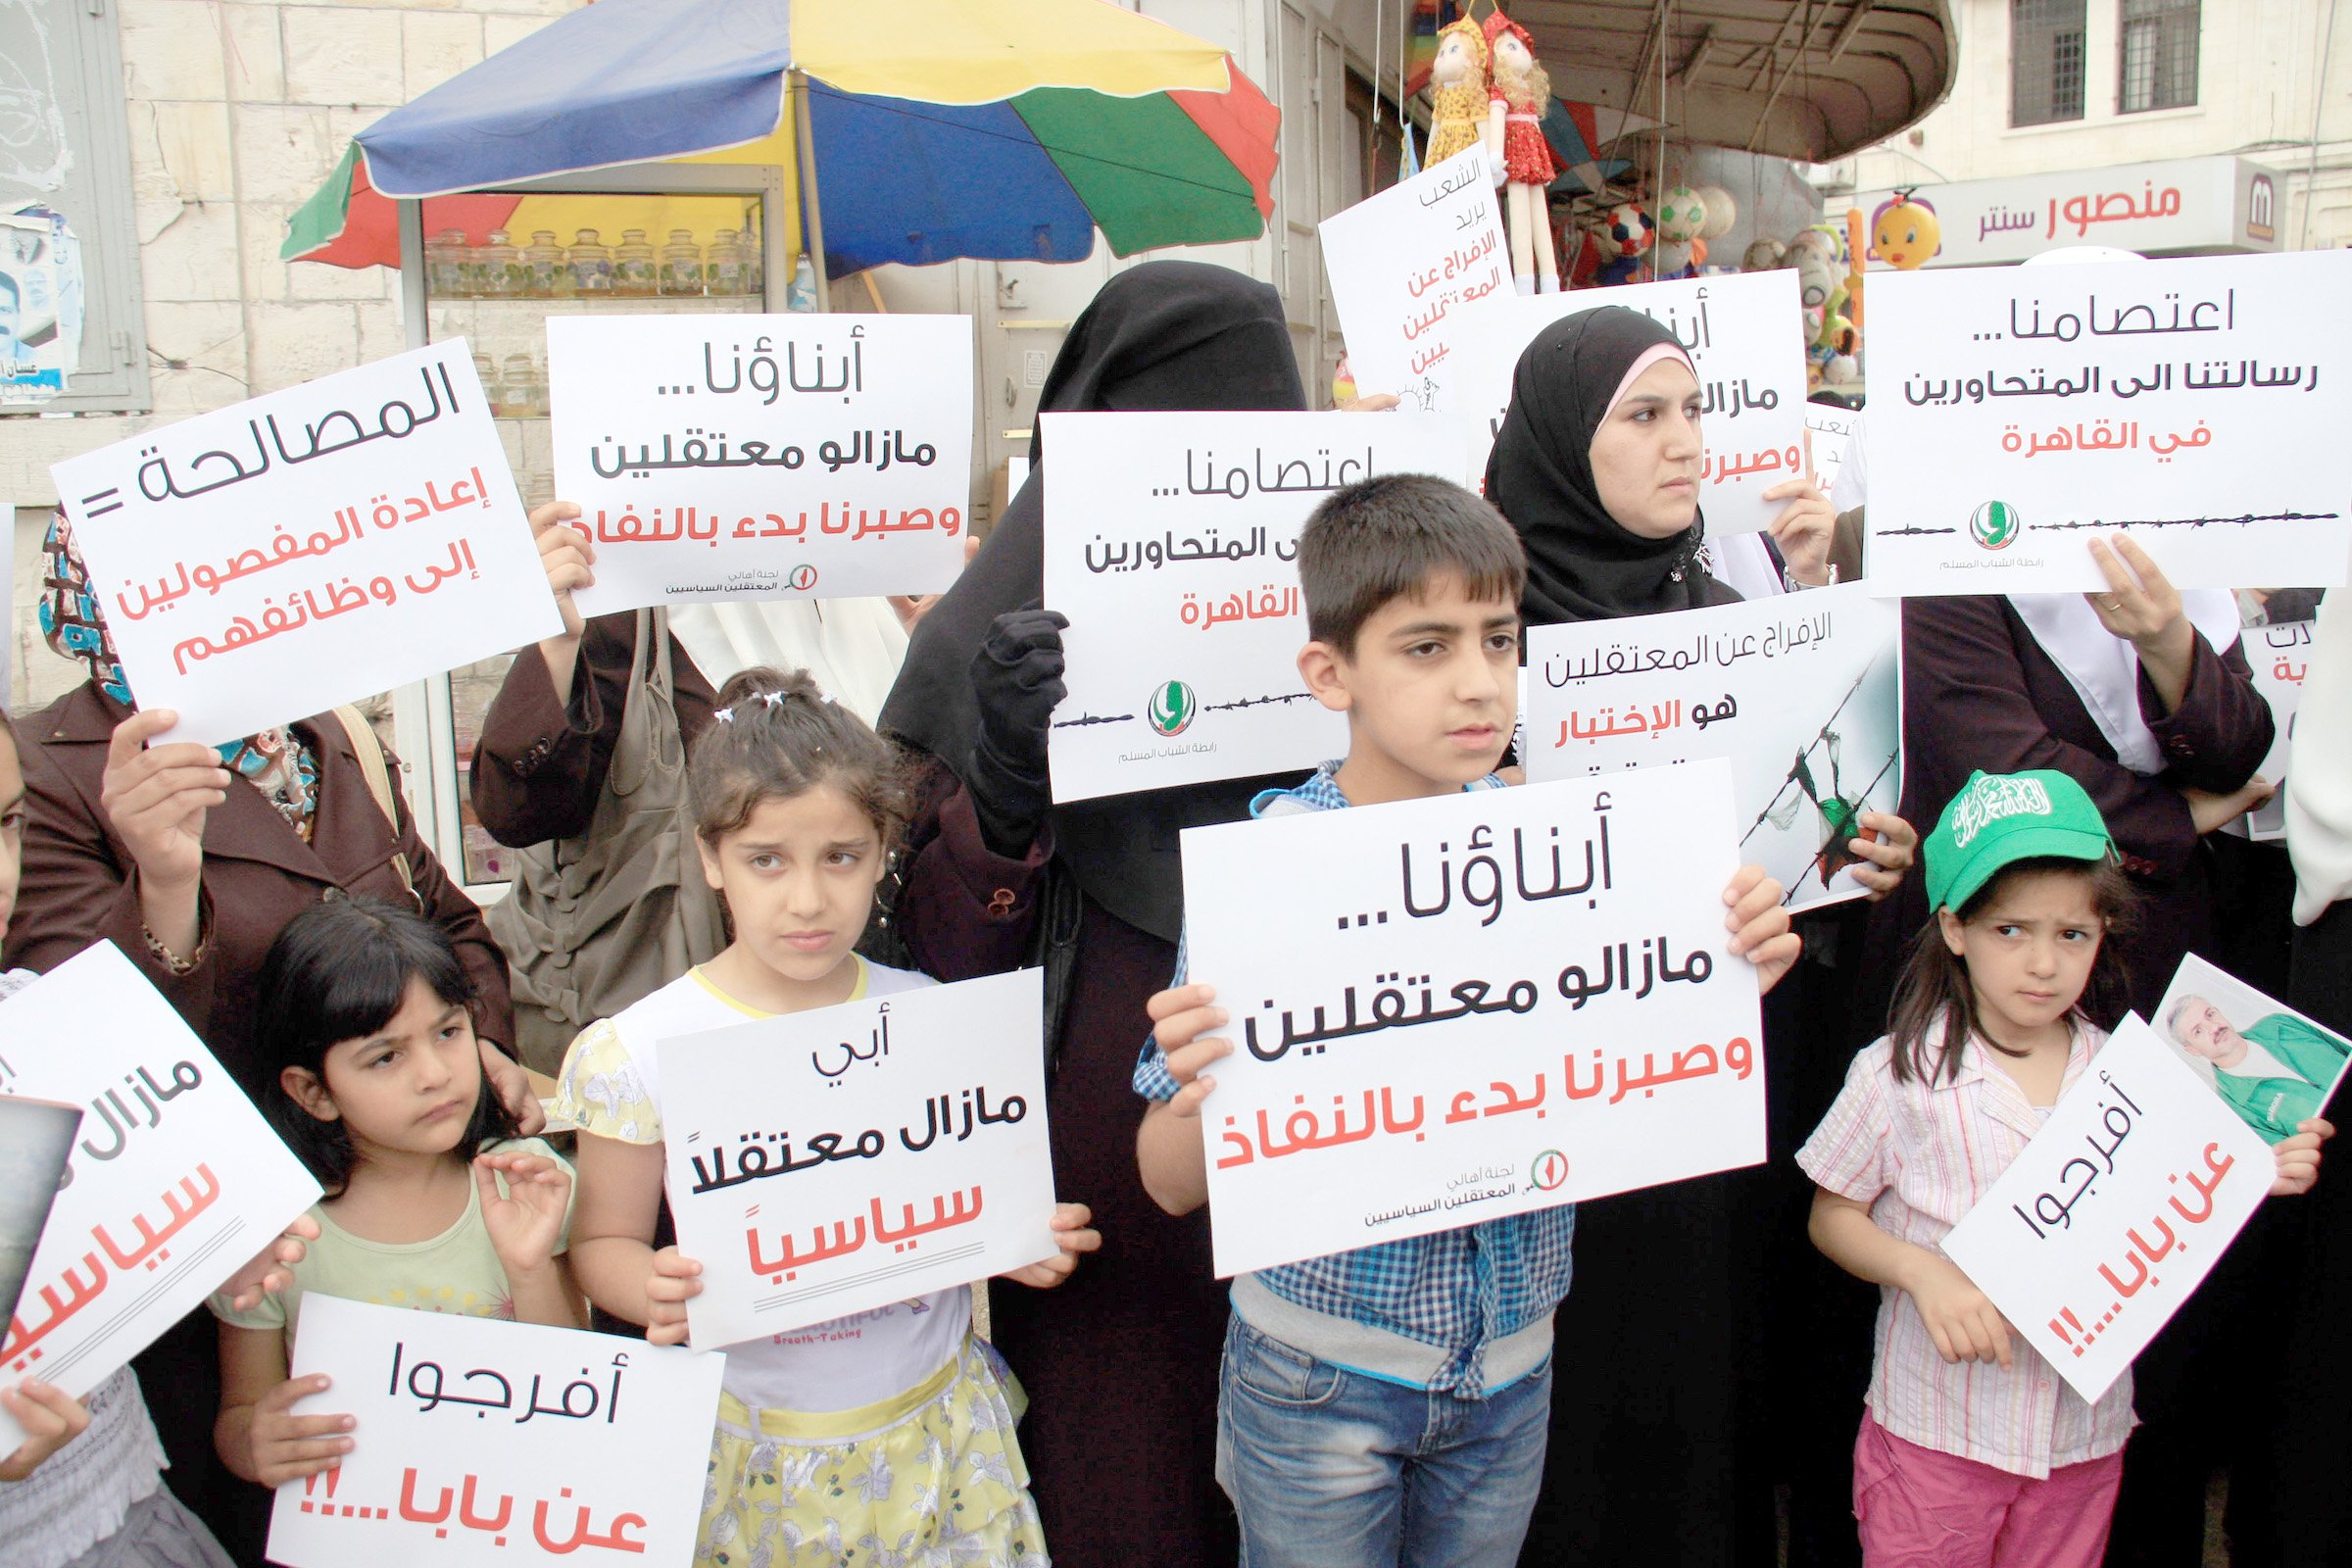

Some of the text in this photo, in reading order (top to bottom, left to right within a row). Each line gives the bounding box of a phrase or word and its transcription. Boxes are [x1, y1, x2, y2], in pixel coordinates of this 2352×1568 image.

[1419, 158, 1481, 209] الشعب
[1979, 179, 2181, 241] منصور سنتر
[1456, 201, 1488, 231] يريد
[1407, 229, 1497, 298] الإفراج عن
[1701, 378, 1779, 418] مازال
[1904, 360, 2319, 405] رسالتنا الى المتحاورين
[138, 361, 461, 503] المصالحة
[590, 428, 937, 479] مازالو معتقلين
[2001, 417, 2212, 464] في القاهرة
[1700, 445, 1801, 485] وصبرن
[116, 466, 491, 620] إعادة المفصولين
[731, 507, 808, 544] بدء
[821, 502, 961, 541] وصبرنا
[1085, 526, 1266, 573] المتحاورين
[172, 537, 480, 673] إلى وظائفهم
[665, 582, 778, 595] المعتقلين السياسيين
[1180, 584, 1298, 631] القاهرة
[1545, 612, 1832, 688] الإفراج عن المعتقلين
[1555, 694, 1738, 749] هو الإختبار
[1118, 748, 1156, 764] المسلم
[1245, 936, 1713, 1061] مازالو معتقلين
[811, 1002, 891, 1088] أبي
[80, 1060, 203, 1161] مازال
[1216, 1035, 1754, 1170] وصبرنا بدء بالنفاذ
[687, 1086, 1028, 1195] مازال معتقلاً
[2011, 1068, 2144, 1240] أفرجوا
[1364, 1183, 1516, 1227] المعتقلين السياسيين
[1446, 1163, 1515, 1193] لجنة أهالي
[2167, 1141, 2235, 1224] عن
[0, 1161, 221, 1372] سياسي
[745, 1185, 984, 1286] سياسياً
[389, 1341, 630, 1424] أفرجوا
[532, 1487, 649, 1554] عن
